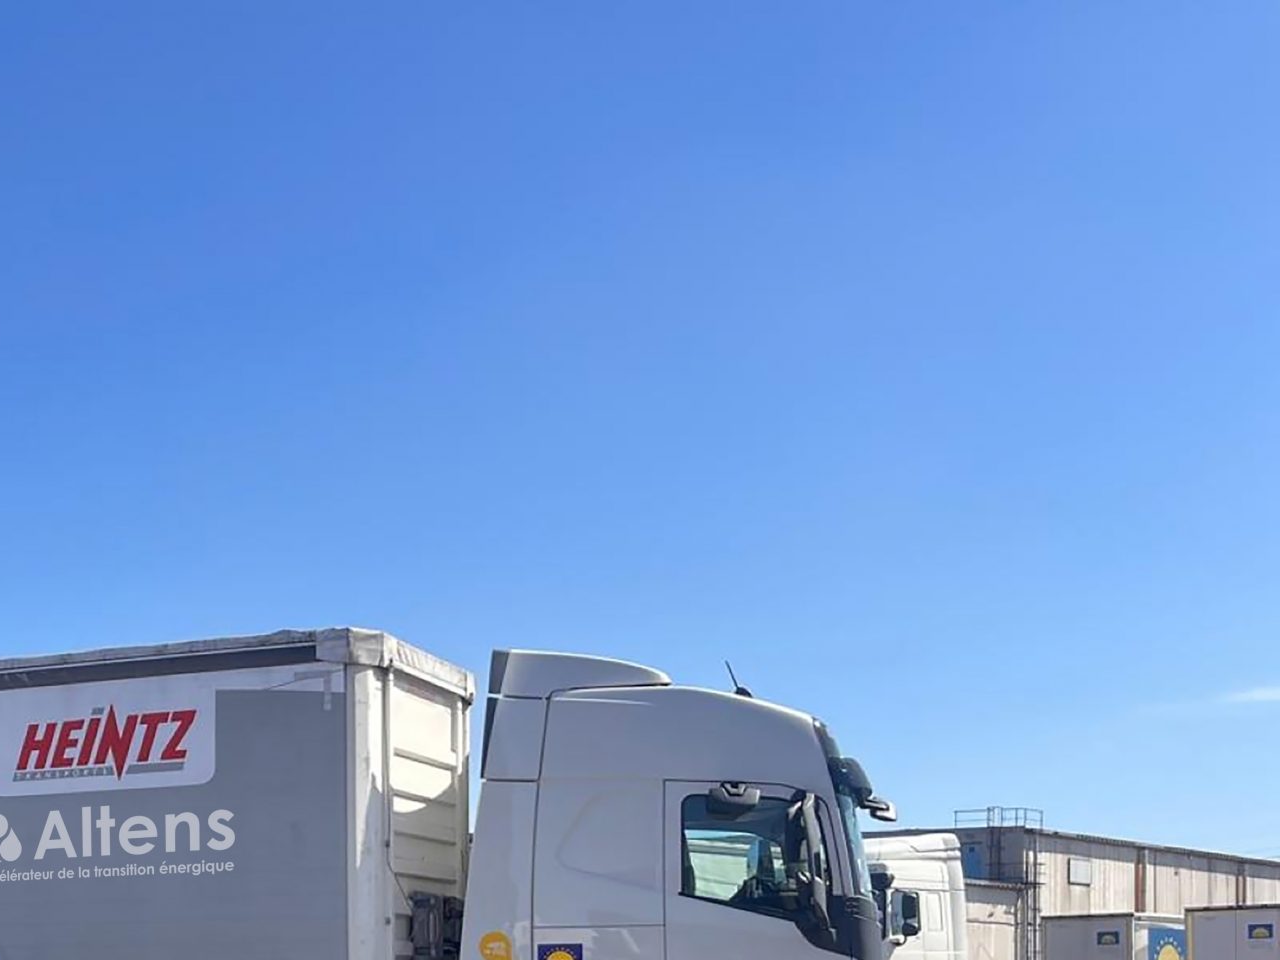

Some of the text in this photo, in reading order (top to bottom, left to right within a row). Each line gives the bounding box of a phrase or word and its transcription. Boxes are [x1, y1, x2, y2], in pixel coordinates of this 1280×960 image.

[34, 805, 236, 860] Altens
[57, 867, 75, 879] de
[78, 866, 90, 878] la
[94, 863, 155, 878] transition
[159, 860, 235, 876] énergique
